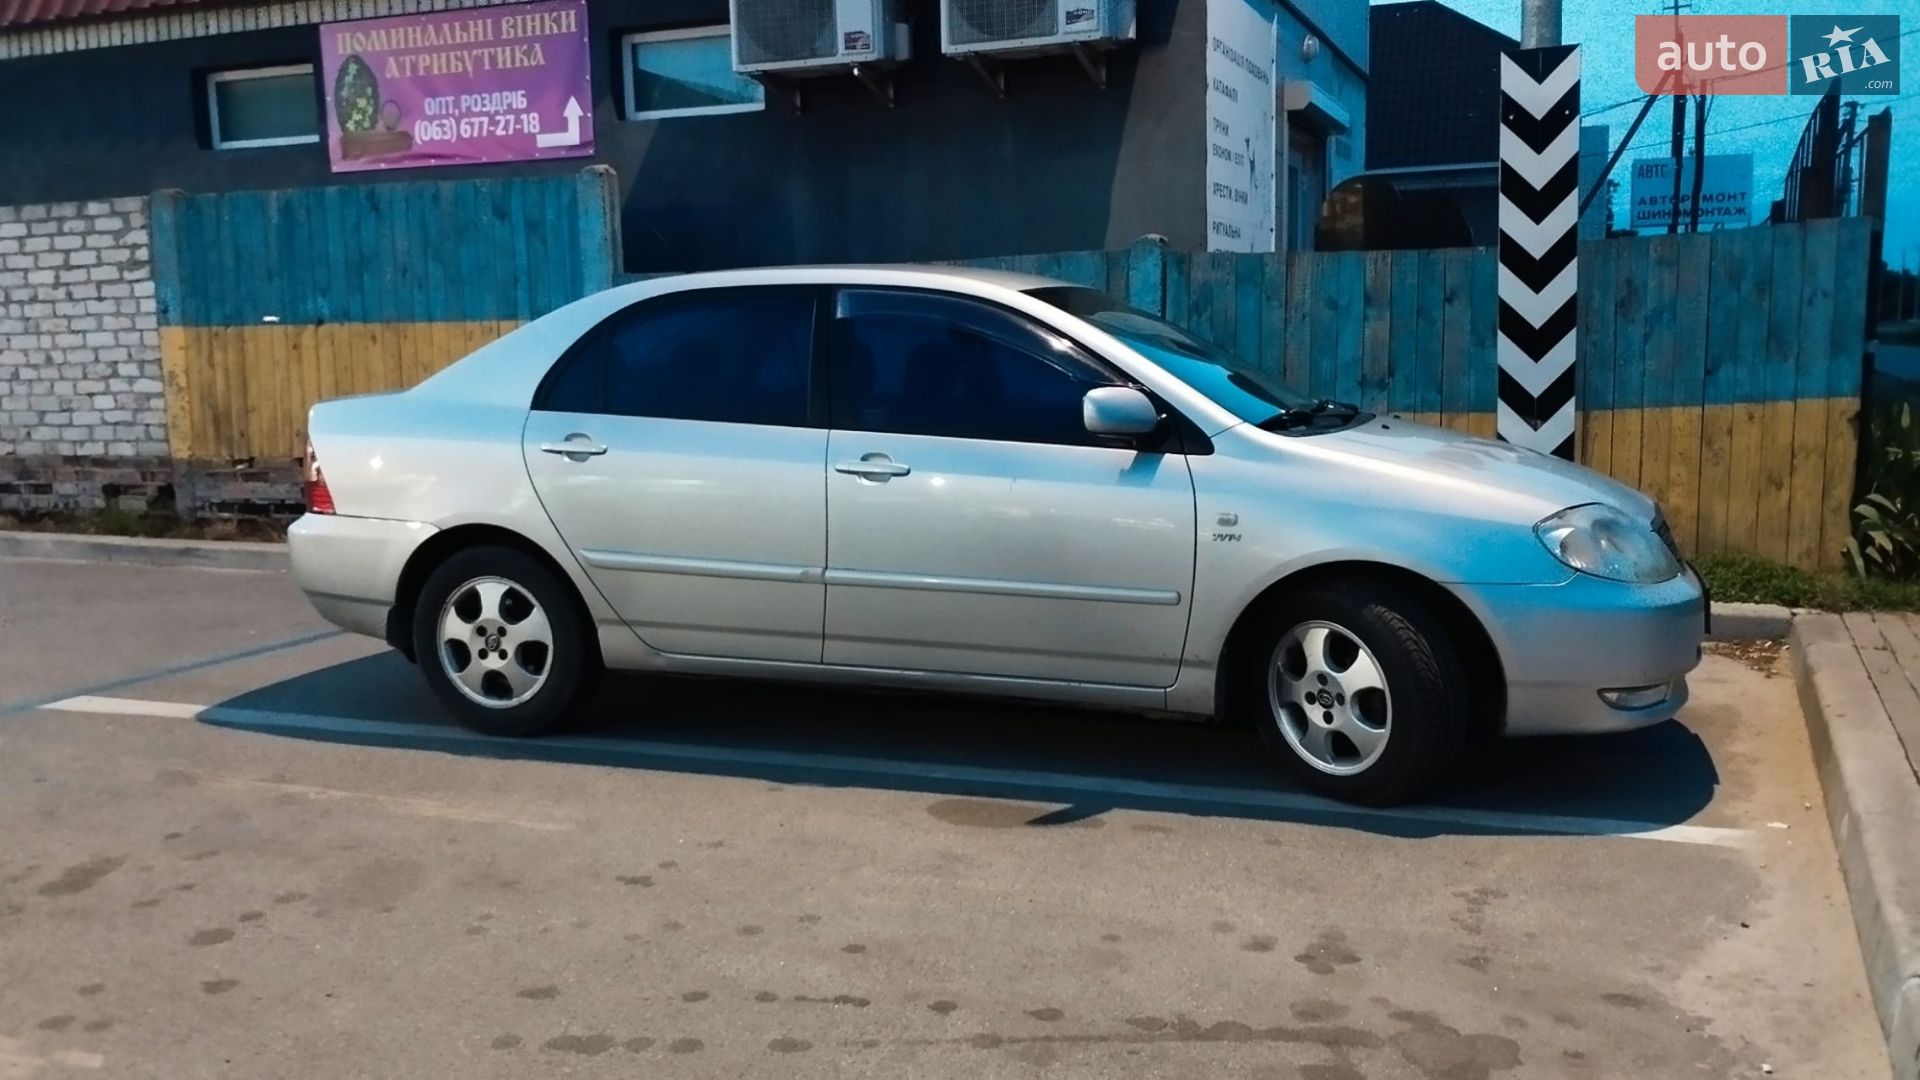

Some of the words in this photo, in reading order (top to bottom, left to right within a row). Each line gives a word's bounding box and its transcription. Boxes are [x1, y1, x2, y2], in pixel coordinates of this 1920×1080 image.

[336, 19, 494, 54] ПОМИНАЛЬНІ
[501, 9, 578, 39] ВІНКИ
[385, 43, 546, 79] АТРИБУТИКА
[424, 96, 459, 116] ОПТ,
[462, 90, 527, 113] РОЗДРІБ
[415, 117, 457, 145] (063)
[460, 113, 540, 138] 677-27-18
[1637, 191, 1748, 206] АВТОРМОНТ
[1637, 206, 1748, 221] ШИНМОНТАЖ
